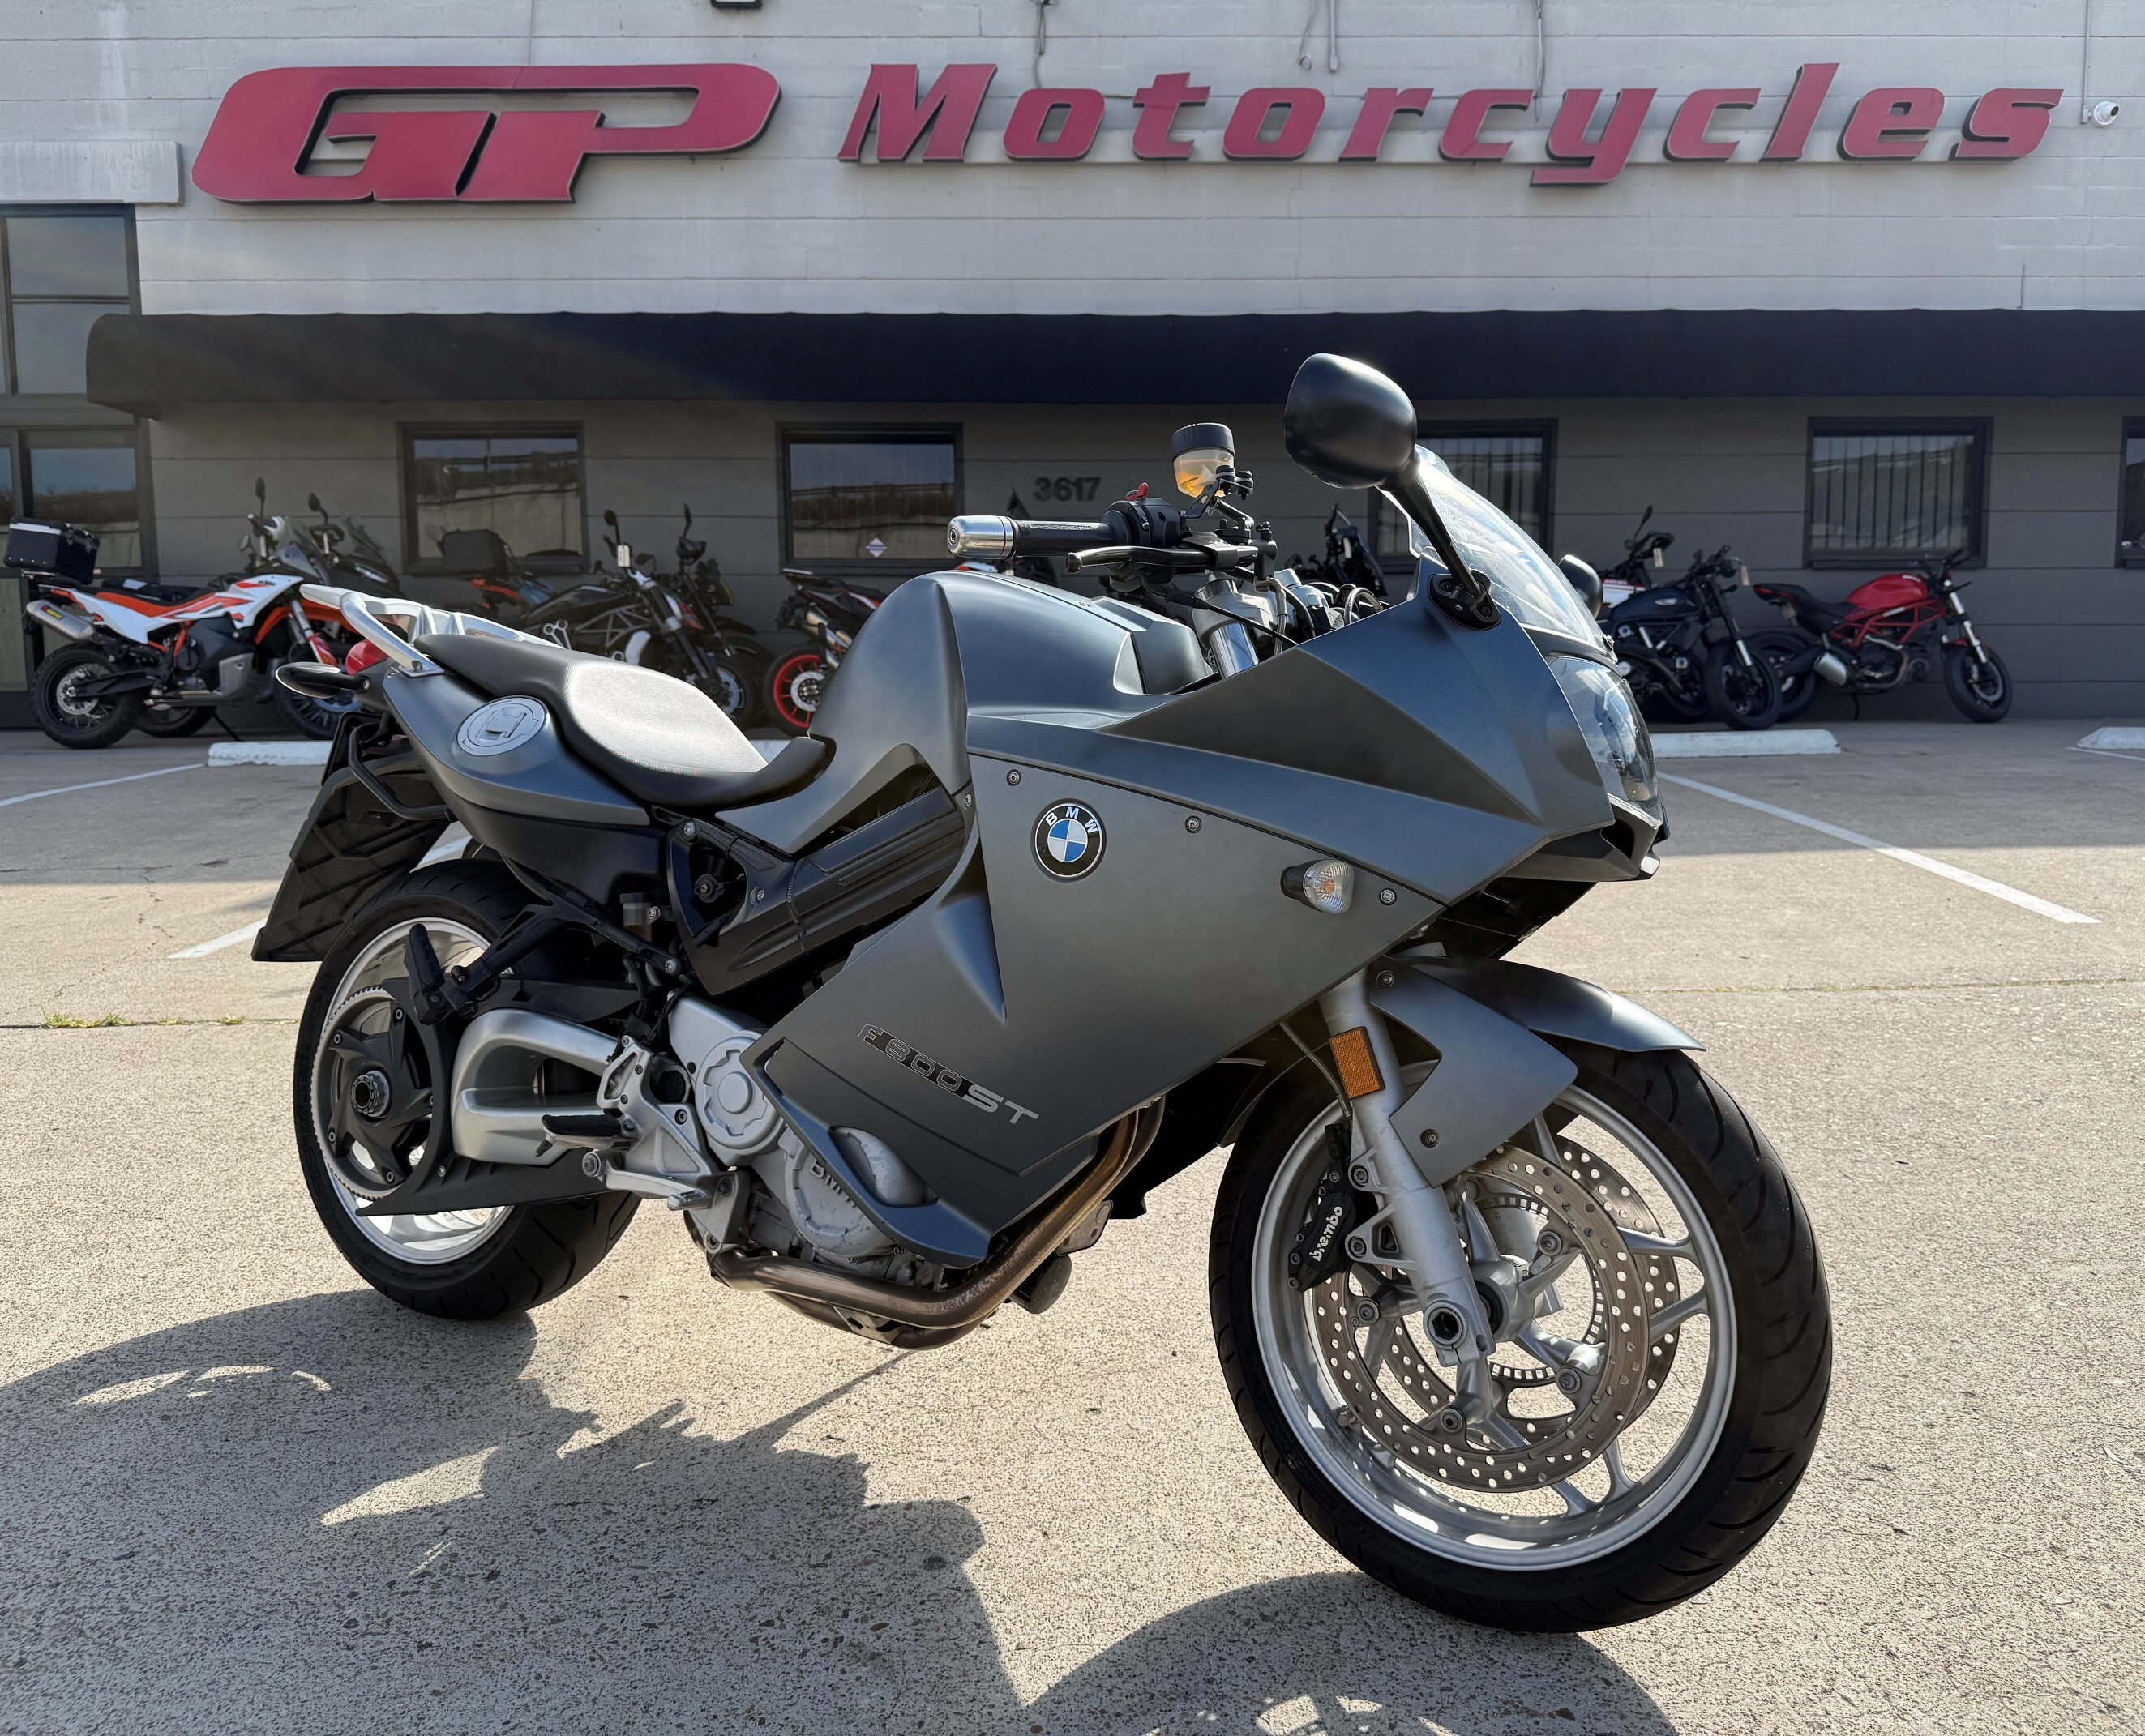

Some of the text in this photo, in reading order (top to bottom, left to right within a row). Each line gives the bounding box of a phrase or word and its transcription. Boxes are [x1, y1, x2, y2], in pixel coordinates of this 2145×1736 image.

[191, 62, 2064, 203] GP Motorcycles
[1034, 477, 1101, 502] 3617
[1045, 806, 1098, 833] BMW
[1309, 1206, 1343, 1262] brembo
